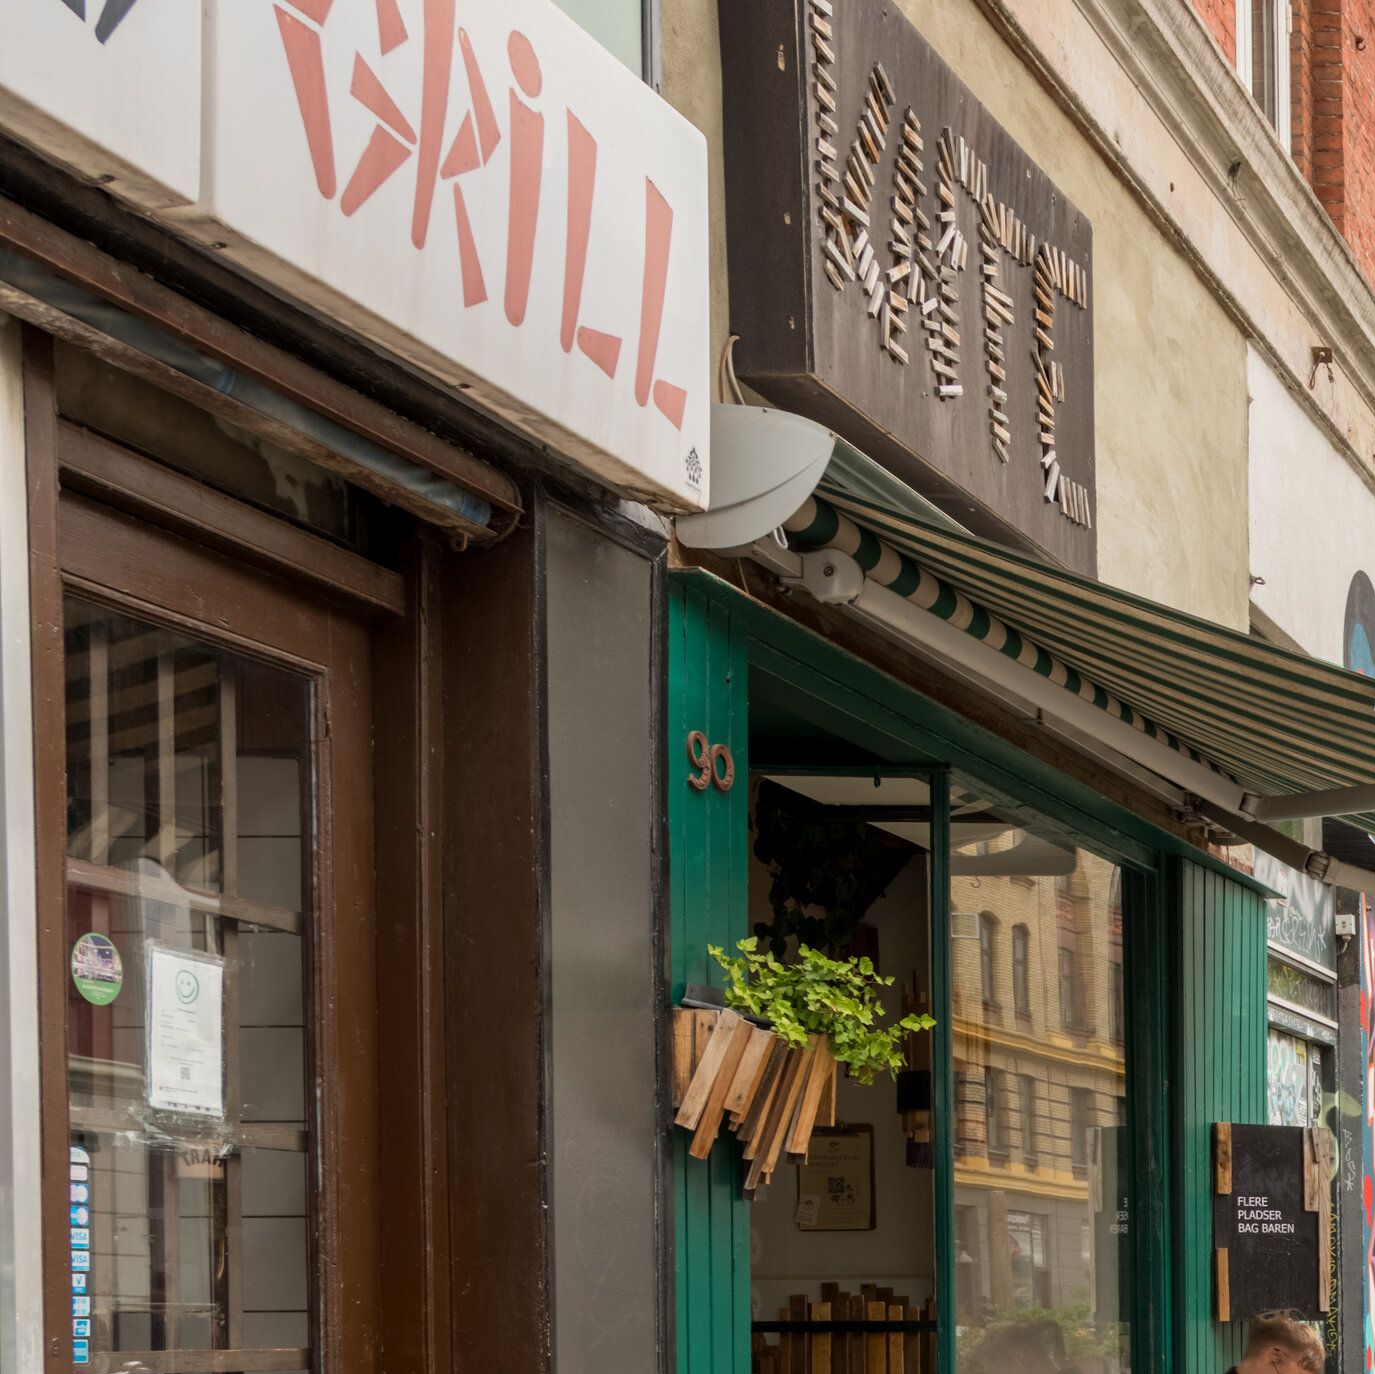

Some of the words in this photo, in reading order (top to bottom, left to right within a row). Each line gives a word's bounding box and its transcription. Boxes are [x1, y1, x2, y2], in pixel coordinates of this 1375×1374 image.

[687, 730, 735, 793] 90
[1237, 1196, 1268, 1207] FLERE
[1237, 1210, 1282, 1221] PLADSER
[1238, 1223, 1259, 1234] BAG
[1262, 1223, 1295, 1234] BAREN
